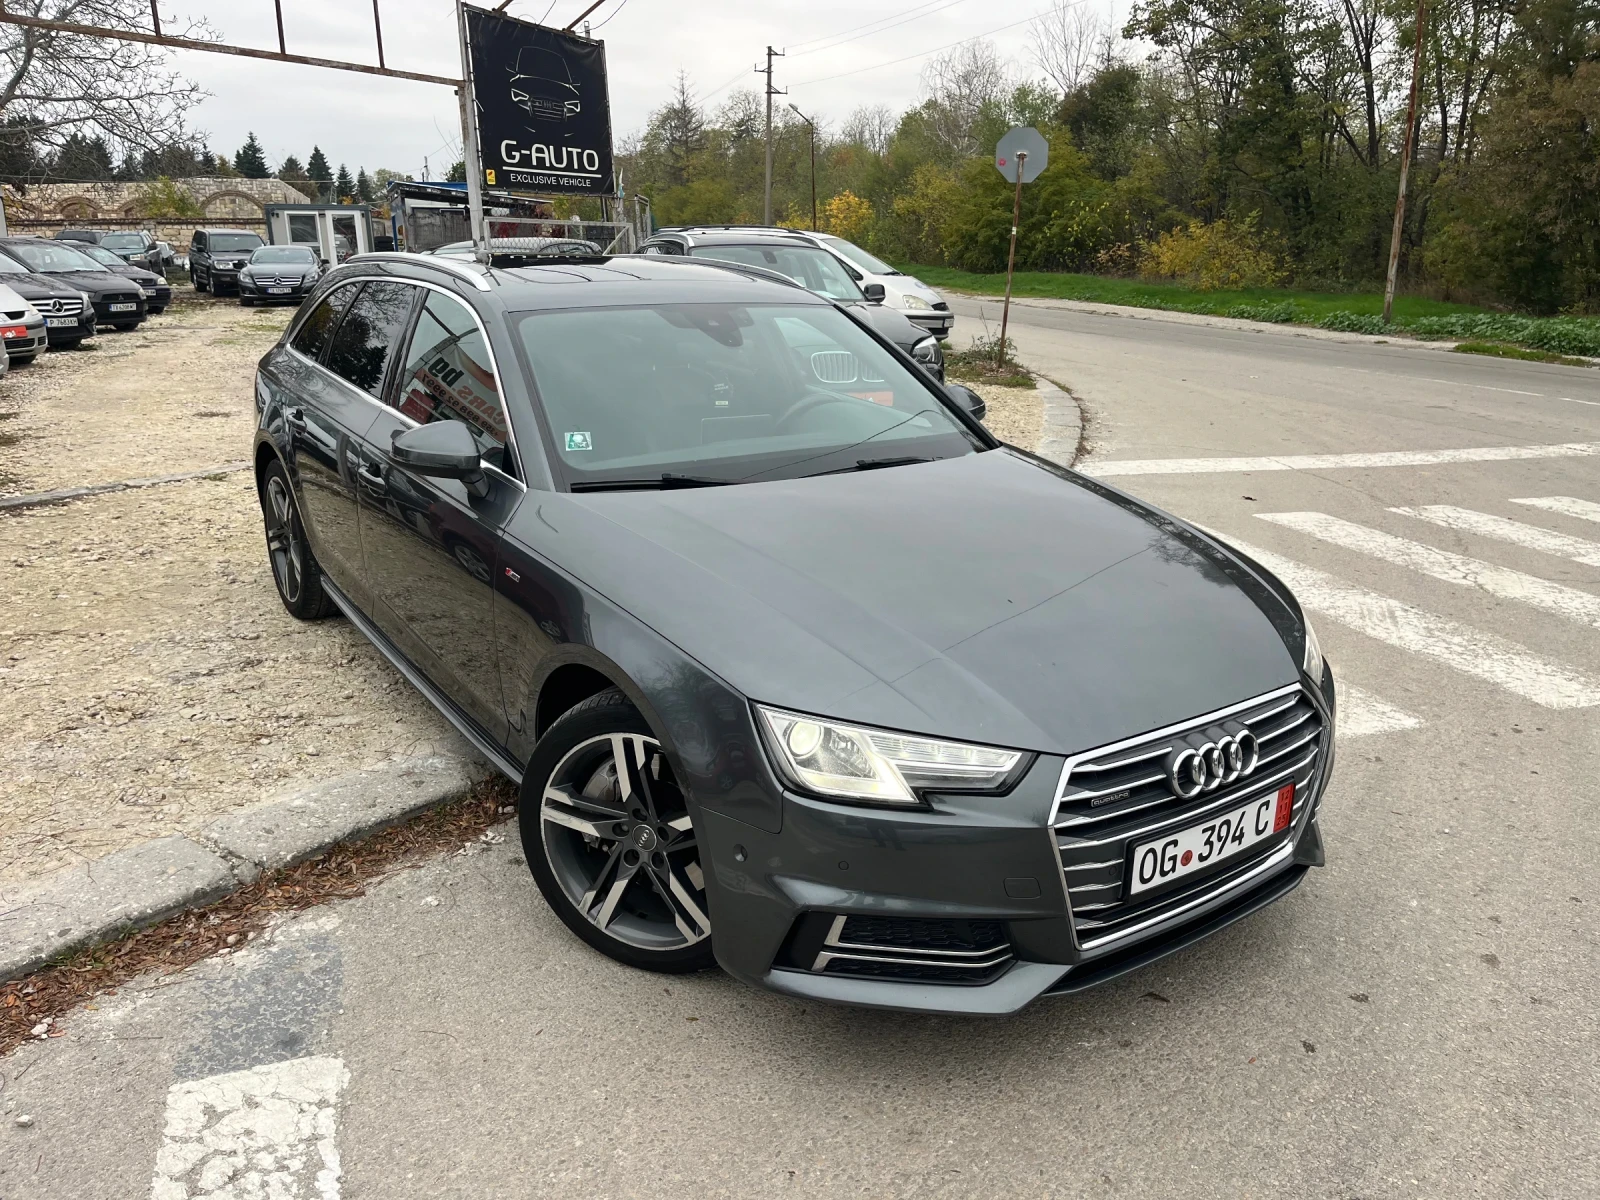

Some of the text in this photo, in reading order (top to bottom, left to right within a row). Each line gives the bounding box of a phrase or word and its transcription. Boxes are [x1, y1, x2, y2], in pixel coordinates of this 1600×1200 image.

[501, 139, 599, 171] G-AUTO
[510, 173, 591, 187] EXCLUSIVE VEHICLE
[1093, 792, 1129, 806] quattro
[1281, 789, 1290, 803] 12
[1279, 802, 1288, 813] 11
[1276, 813, 1287, 827] 25
[1139, 800, 1271, 885] OG 394 C
